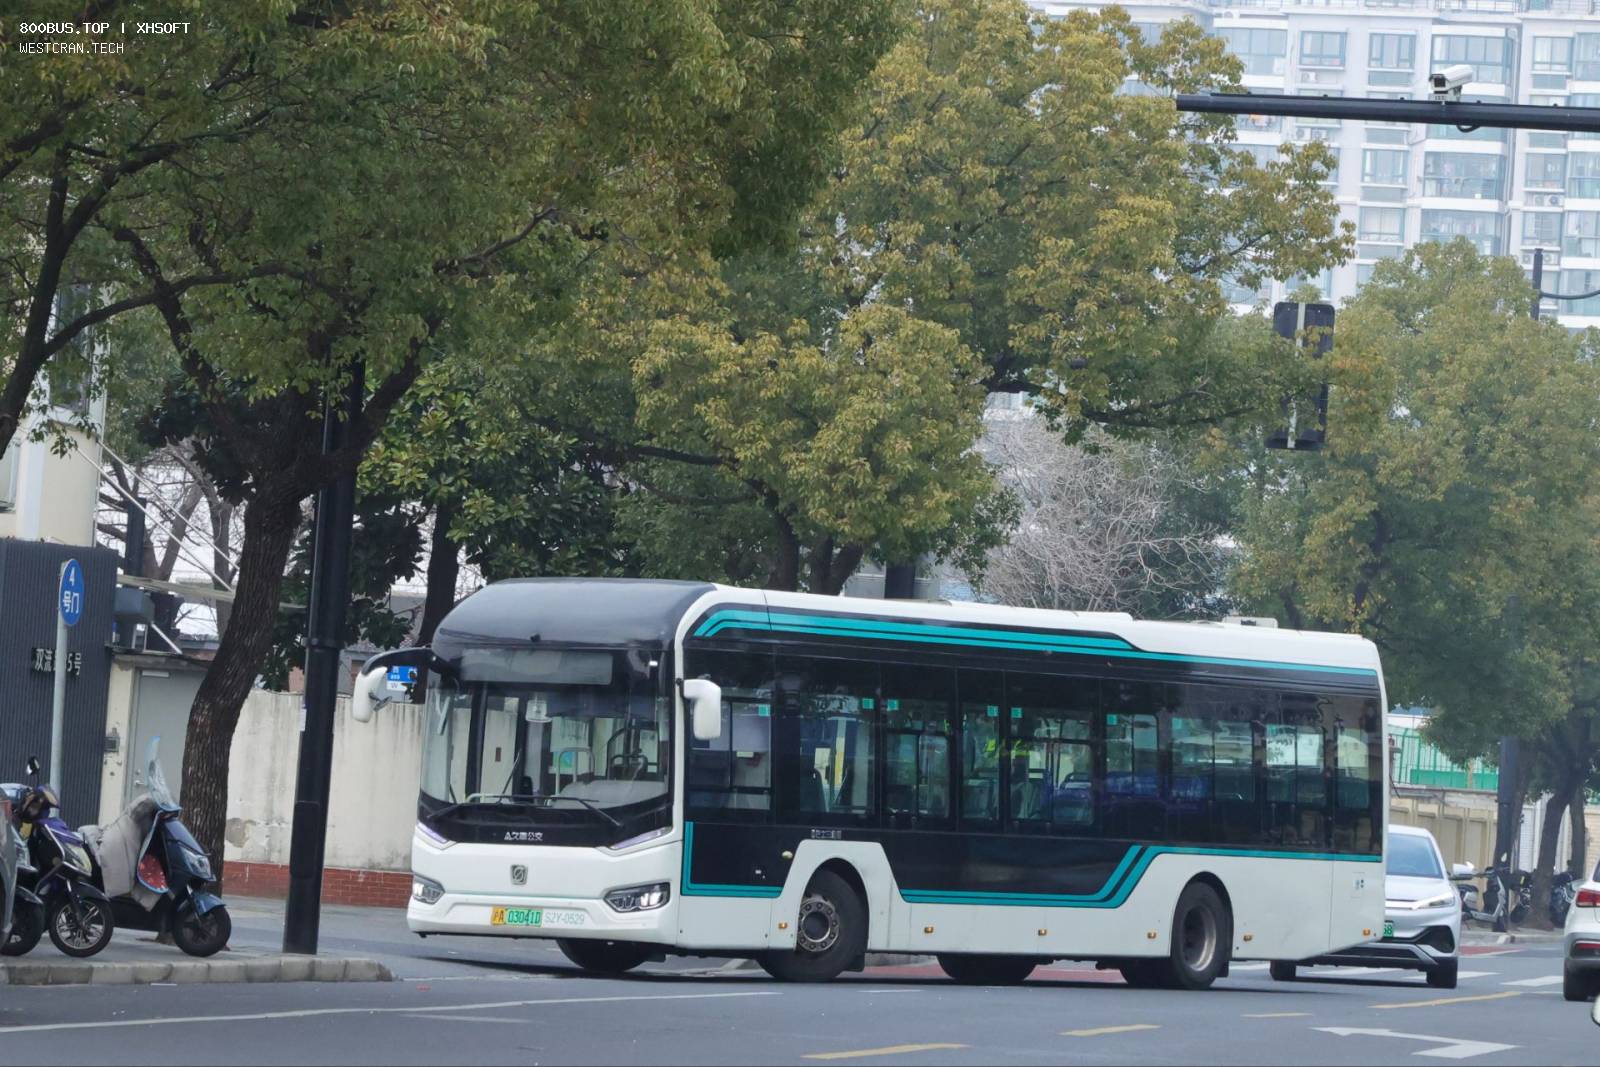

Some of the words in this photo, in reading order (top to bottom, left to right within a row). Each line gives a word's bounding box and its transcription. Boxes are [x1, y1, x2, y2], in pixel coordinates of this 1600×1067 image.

[69, 567, 75, 586] 4
[62, 590, 80, 614] 号门
[35, 648, 81, 676] 双流5号
